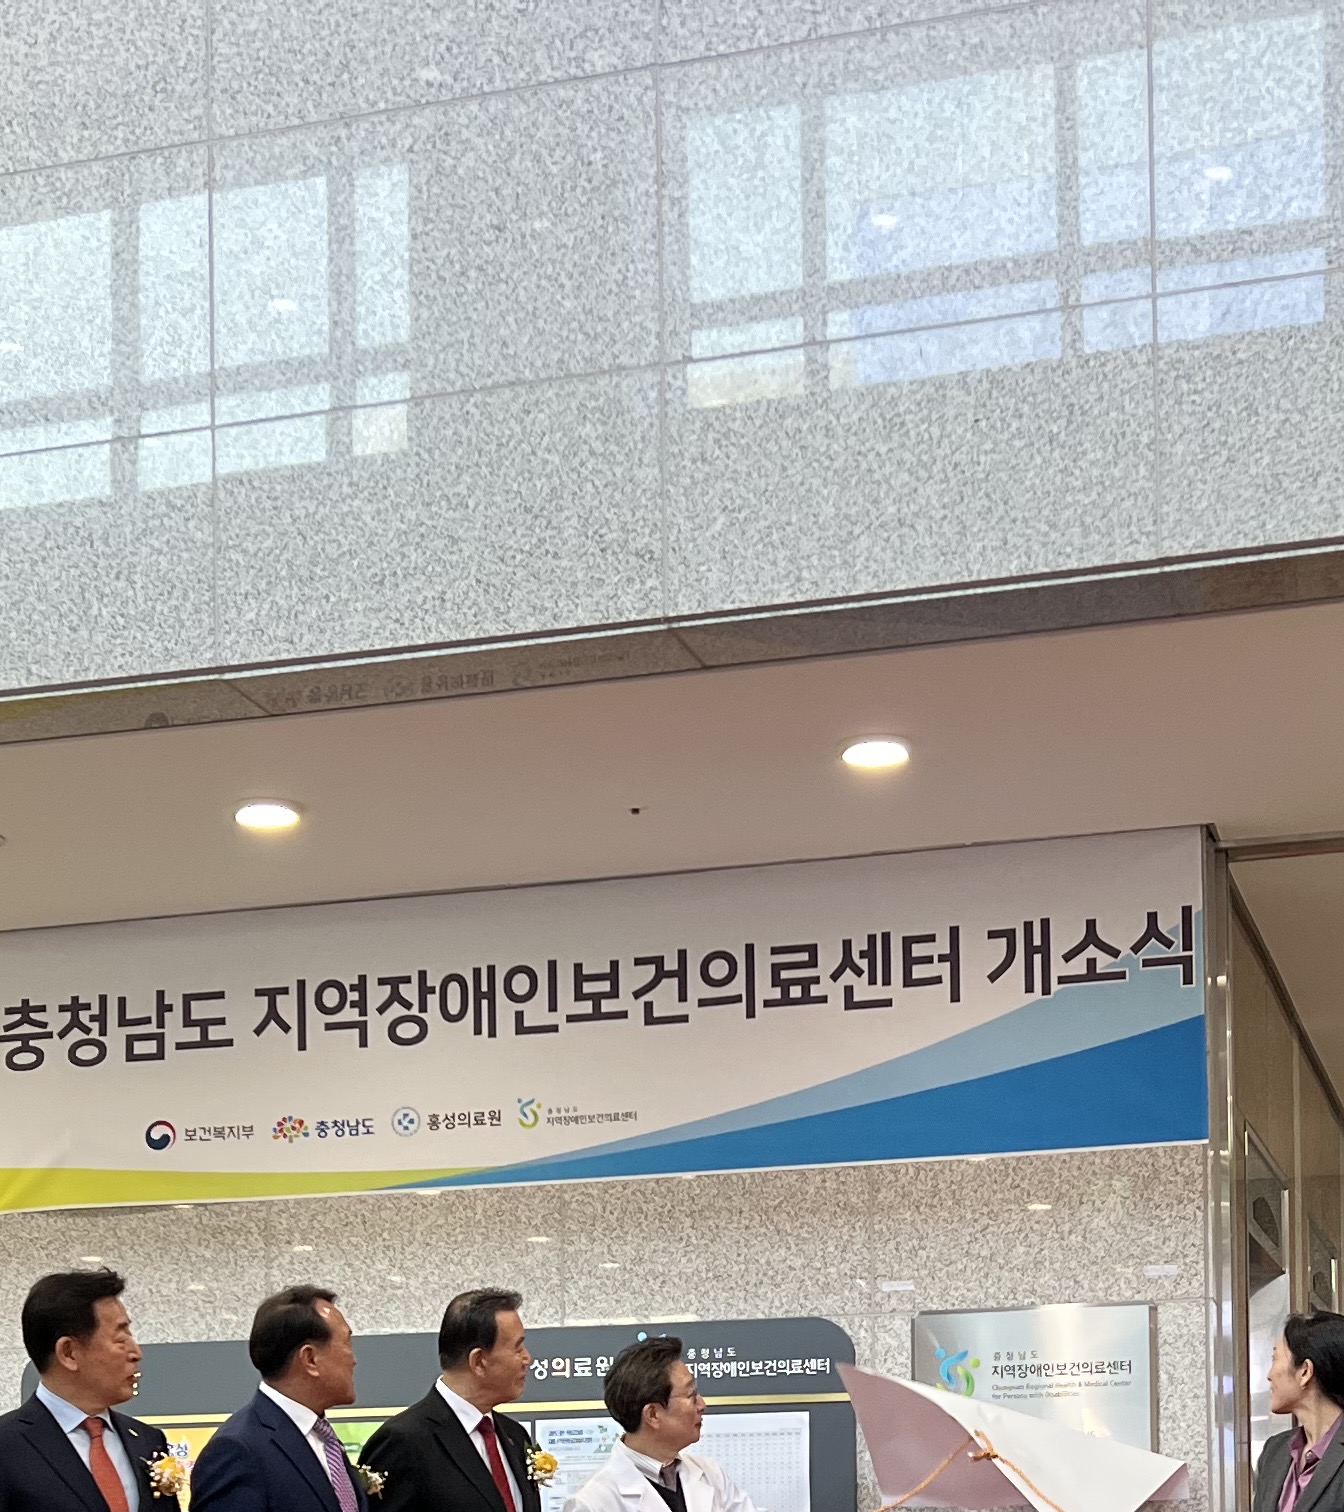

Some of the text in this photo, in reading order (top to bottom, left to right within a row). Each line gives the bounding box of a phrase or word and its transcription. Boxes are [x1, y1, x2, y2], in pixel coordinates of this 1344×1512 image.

[252, 925, 961, 1052] 지역장애인보건의료센터
[986, 904, 1194, 997] 개소식
[184, 1109, 638, 1142] 보건복지부 충청남도 홍성의료원 지역장애인보건의료센터
[687, 1347, 737, 1359] 충청남도
[993, 1350, 1039, 1361] 충청남도
[530, 1356, 830, 1380] 성의료원 지역장애인보건의료센터
[991, 1360, 1133, 1379] 지역장애인보건의료센터
